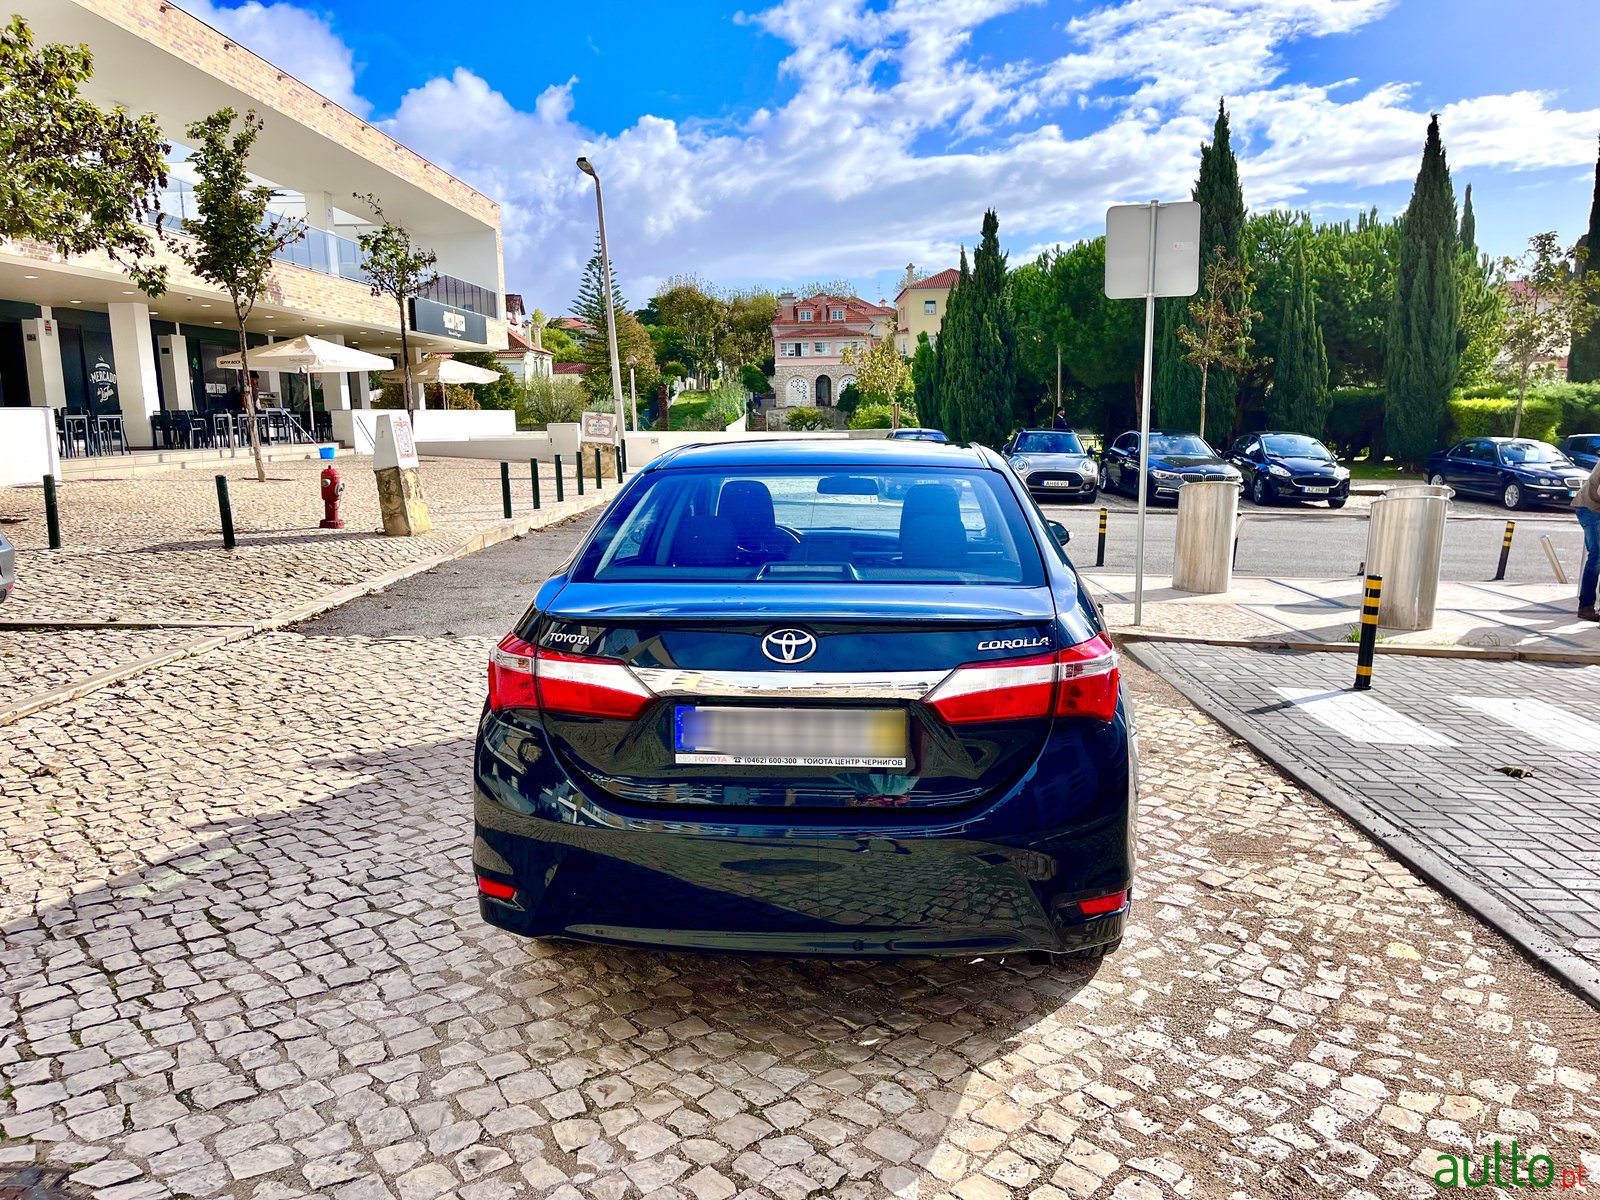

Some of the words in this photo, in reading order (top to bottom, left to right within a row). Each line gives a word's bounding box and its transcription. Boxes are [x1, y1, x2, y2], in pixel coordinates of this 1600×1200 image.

[90, 370, 117, 384] MERCADO
[550, 632, 590, 646] TOYOTA
[977, 637, 1049, 651] COROLLA
[694, 755, 728, 763] TOYOTA
[768, 757, 798, 765] 600-300
[834, 758, 861, 766] ЦЕНТР
